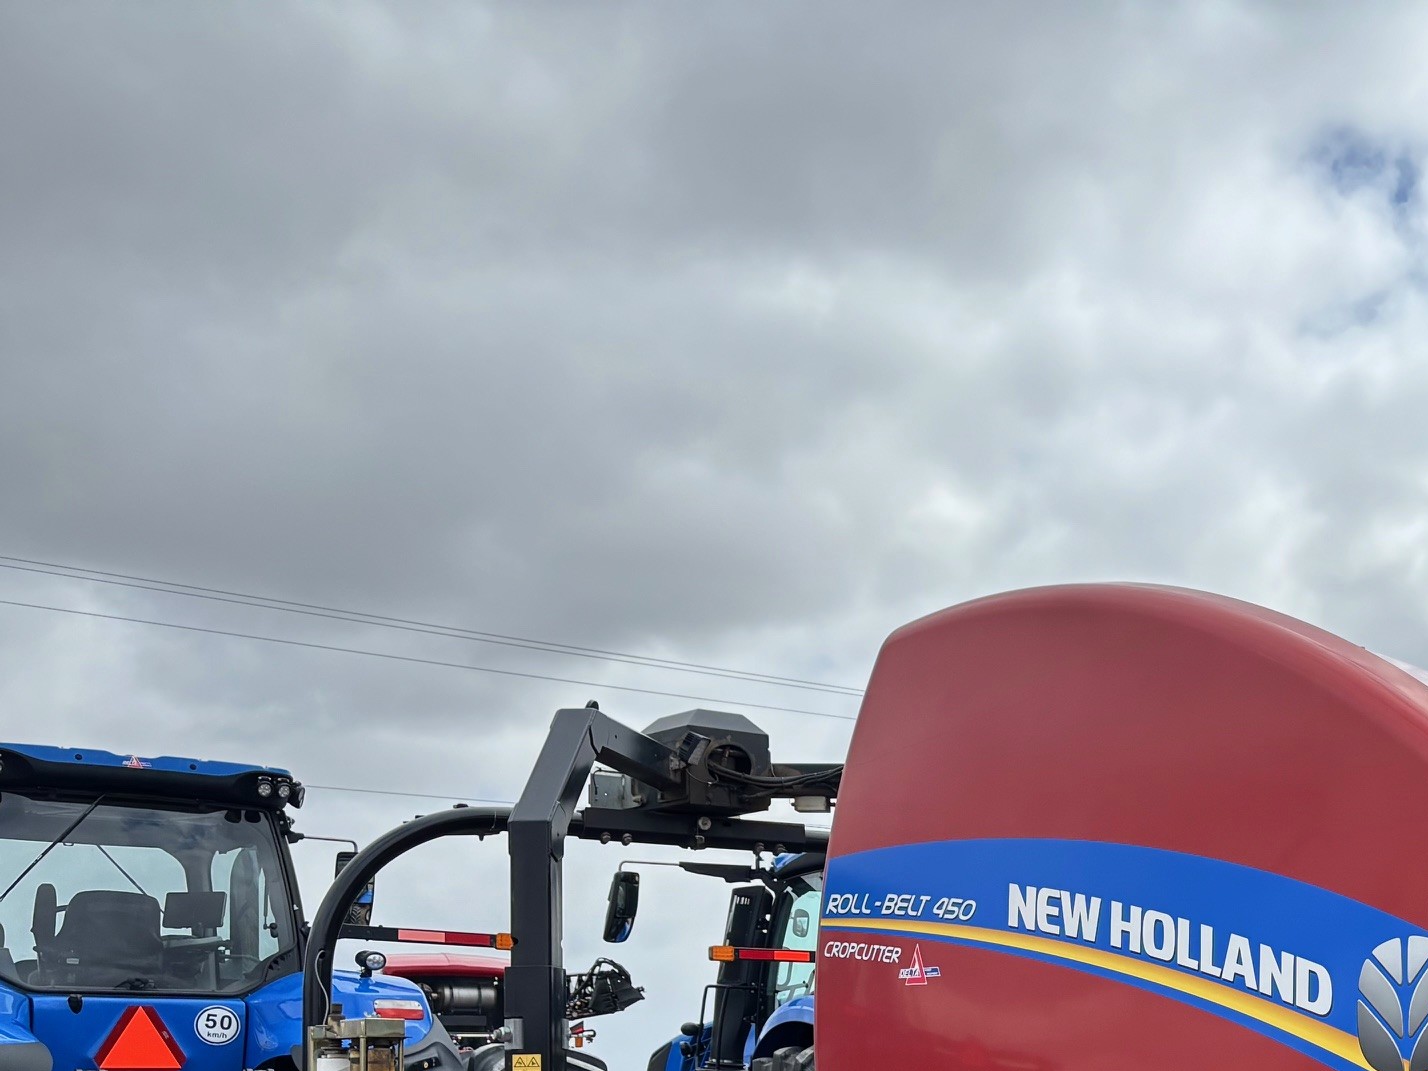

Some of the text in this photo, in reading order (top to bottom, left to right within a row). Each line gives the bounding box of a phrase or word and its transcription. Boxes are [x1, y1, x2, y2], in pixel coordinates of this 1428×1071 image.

[825, 893, 977, 921] ROLL-BELT 450
[824, 941, 901, 964] CROPCUTTER
[1007, 882, 1333, 1017] NEW HOLLAND
[204, 1013, 233, 1031] 50
[207, 1031, 228, 1039] km/h
